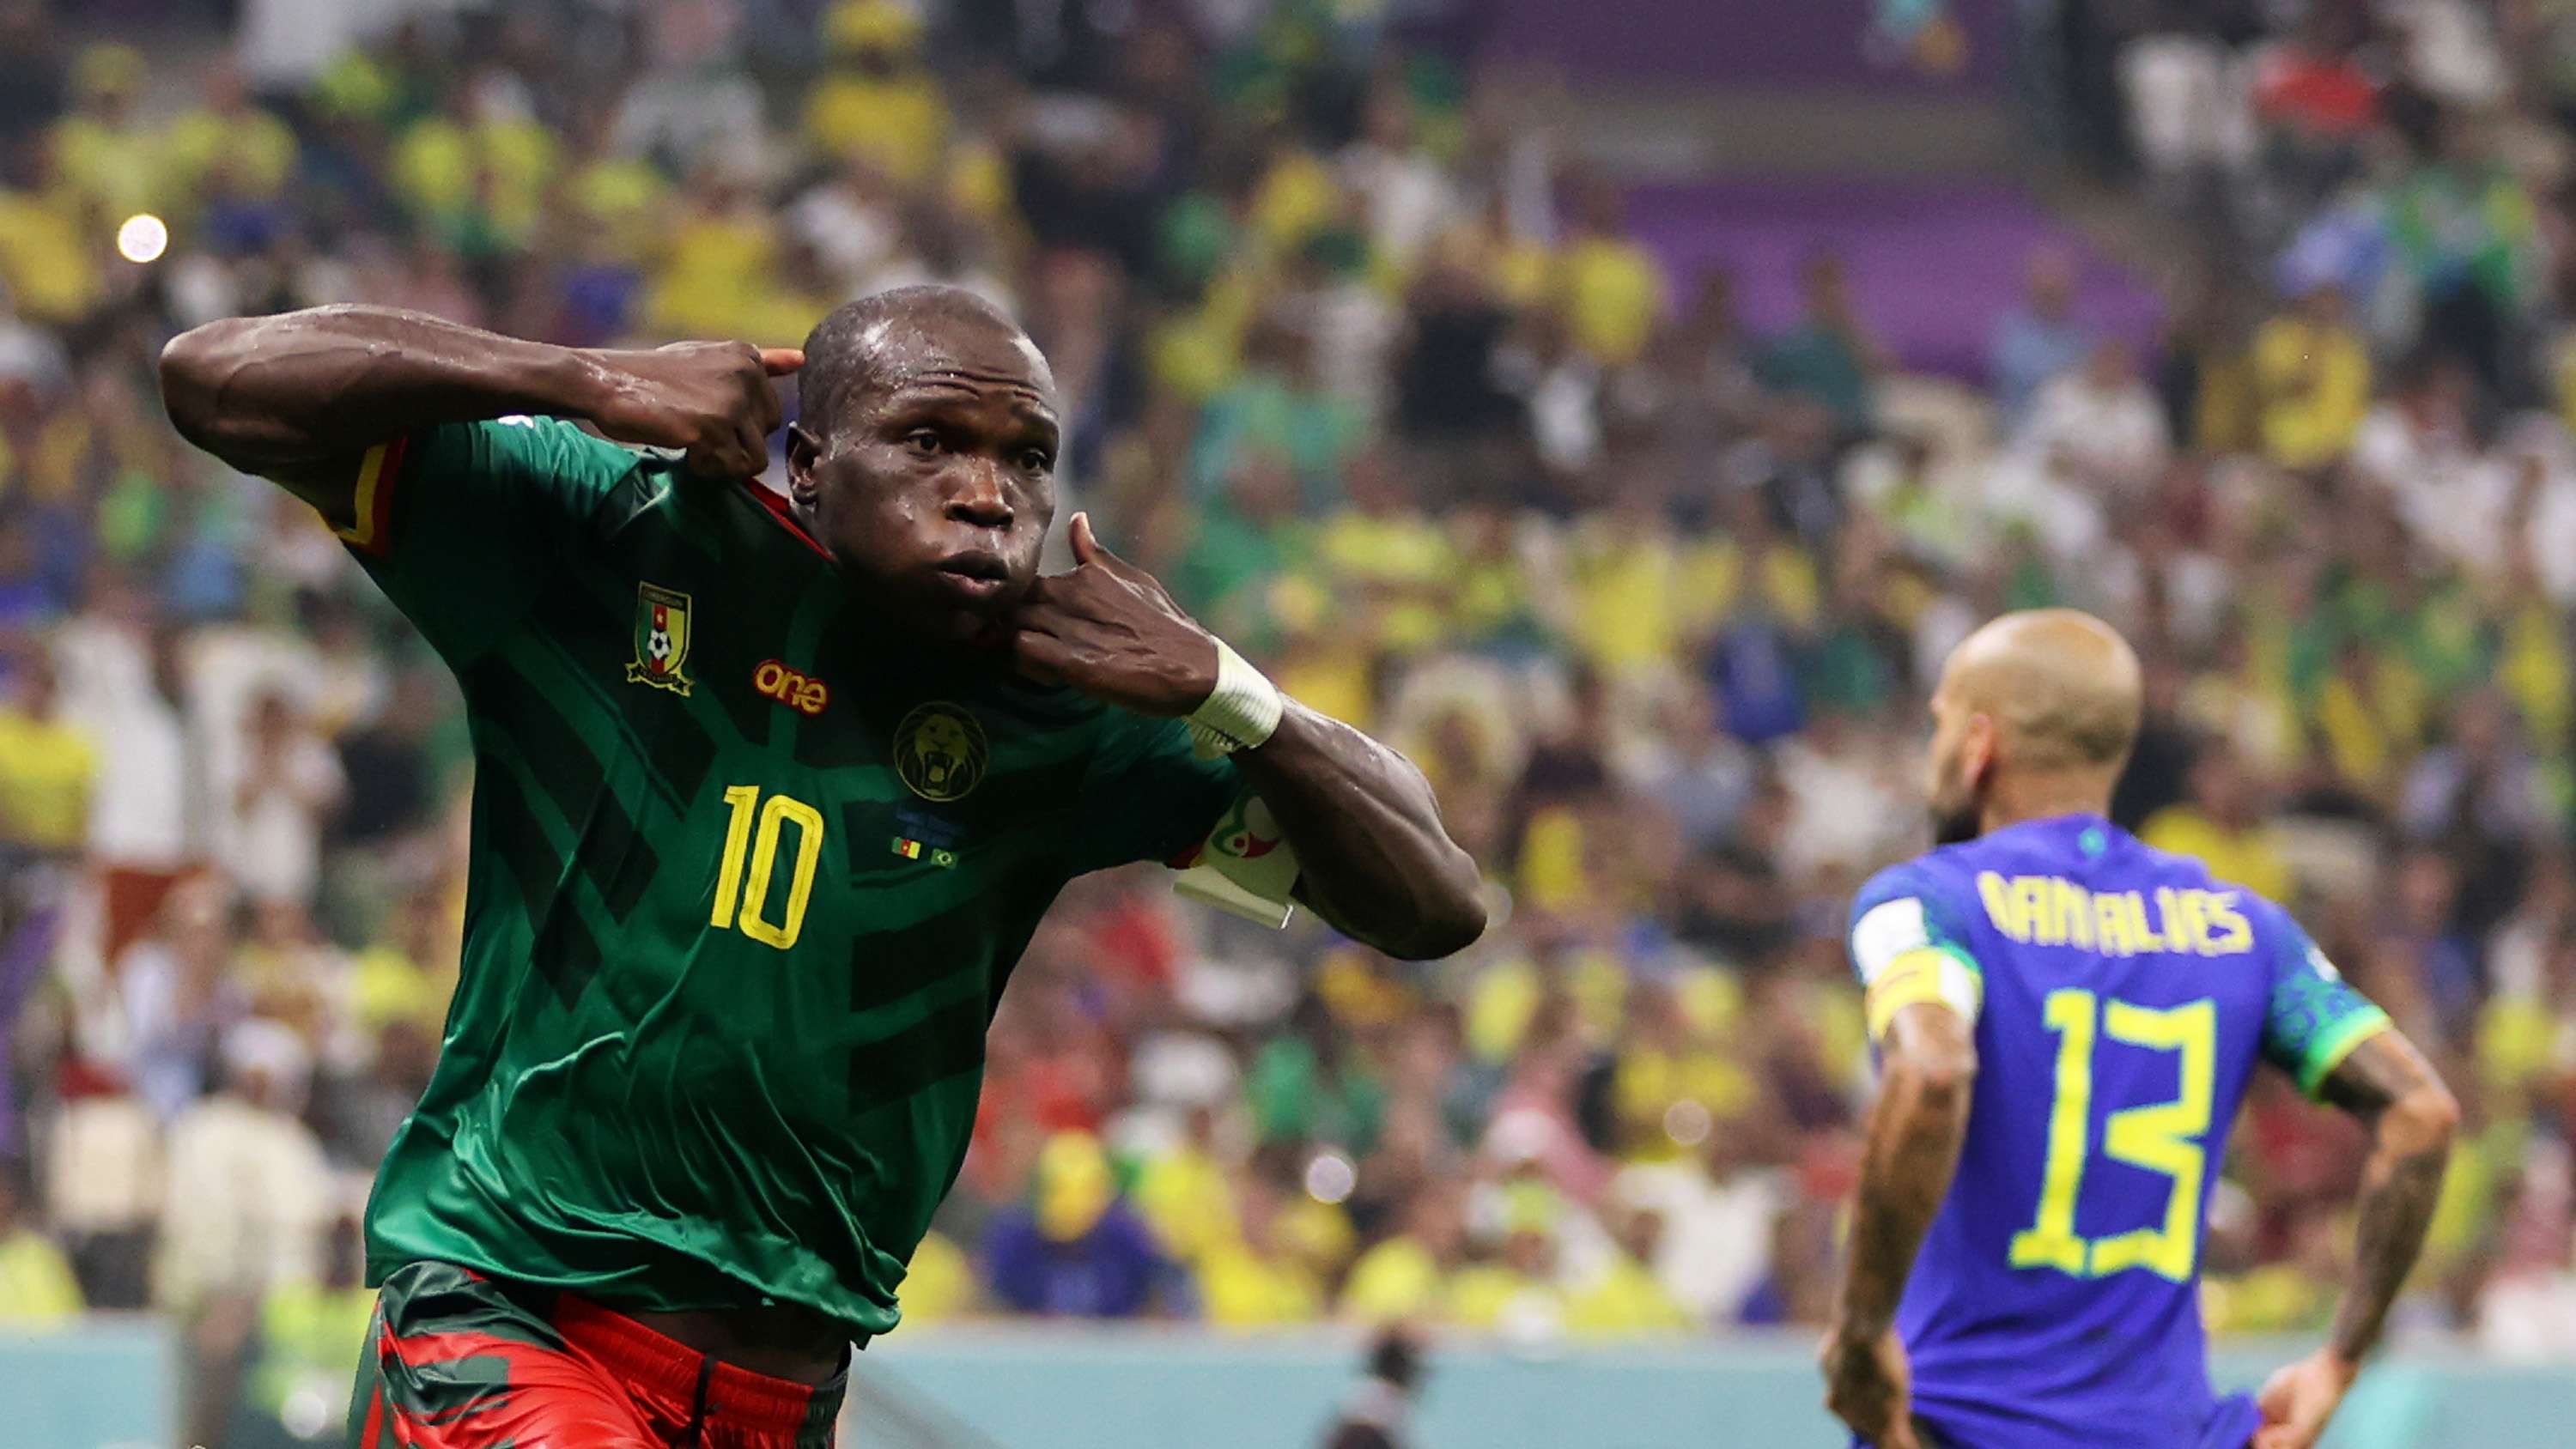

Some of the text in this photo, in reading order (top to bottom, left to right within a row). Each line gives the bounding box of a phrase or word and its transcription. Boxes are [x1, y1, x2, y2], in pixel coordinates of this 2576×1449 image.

[755, 662, 827, 712] one
[711, 785, 824, 949] 10
[2008, 987, 2216, 1282] 13
